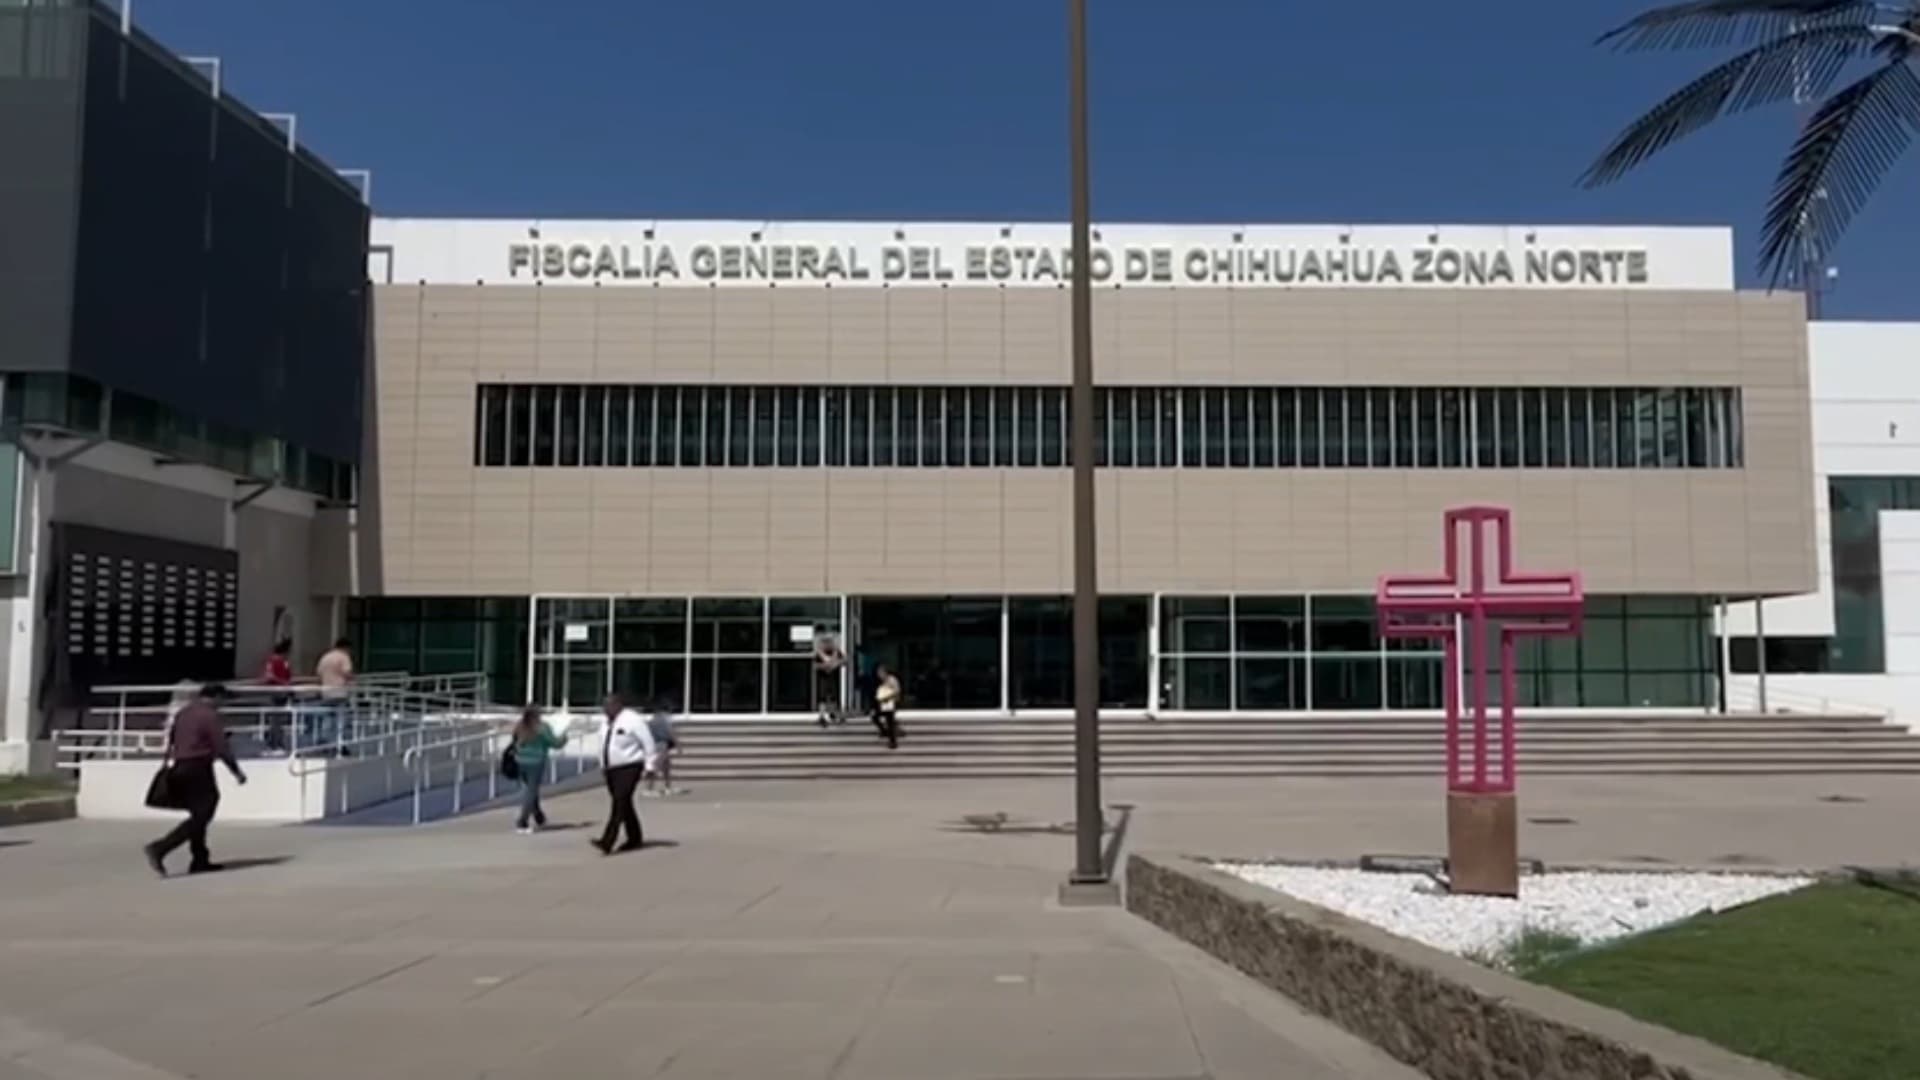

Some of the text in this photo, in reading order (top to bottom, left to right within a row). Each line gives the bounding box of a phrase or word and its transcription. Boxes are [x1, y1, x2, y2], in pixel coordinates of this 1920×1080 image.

[509, 245, 679, 281] FISCALIA
[691, 246, 869, 280] GENERAL
[882, 247, 954, 281] DEL
[1124, 249, 1172, 282] DE
[1184, 249, 1404, 283] CHIHUAHUA
[1411, 250, 1514, 284] ZONA
[1525, 250, 1648, 284] NORTE
